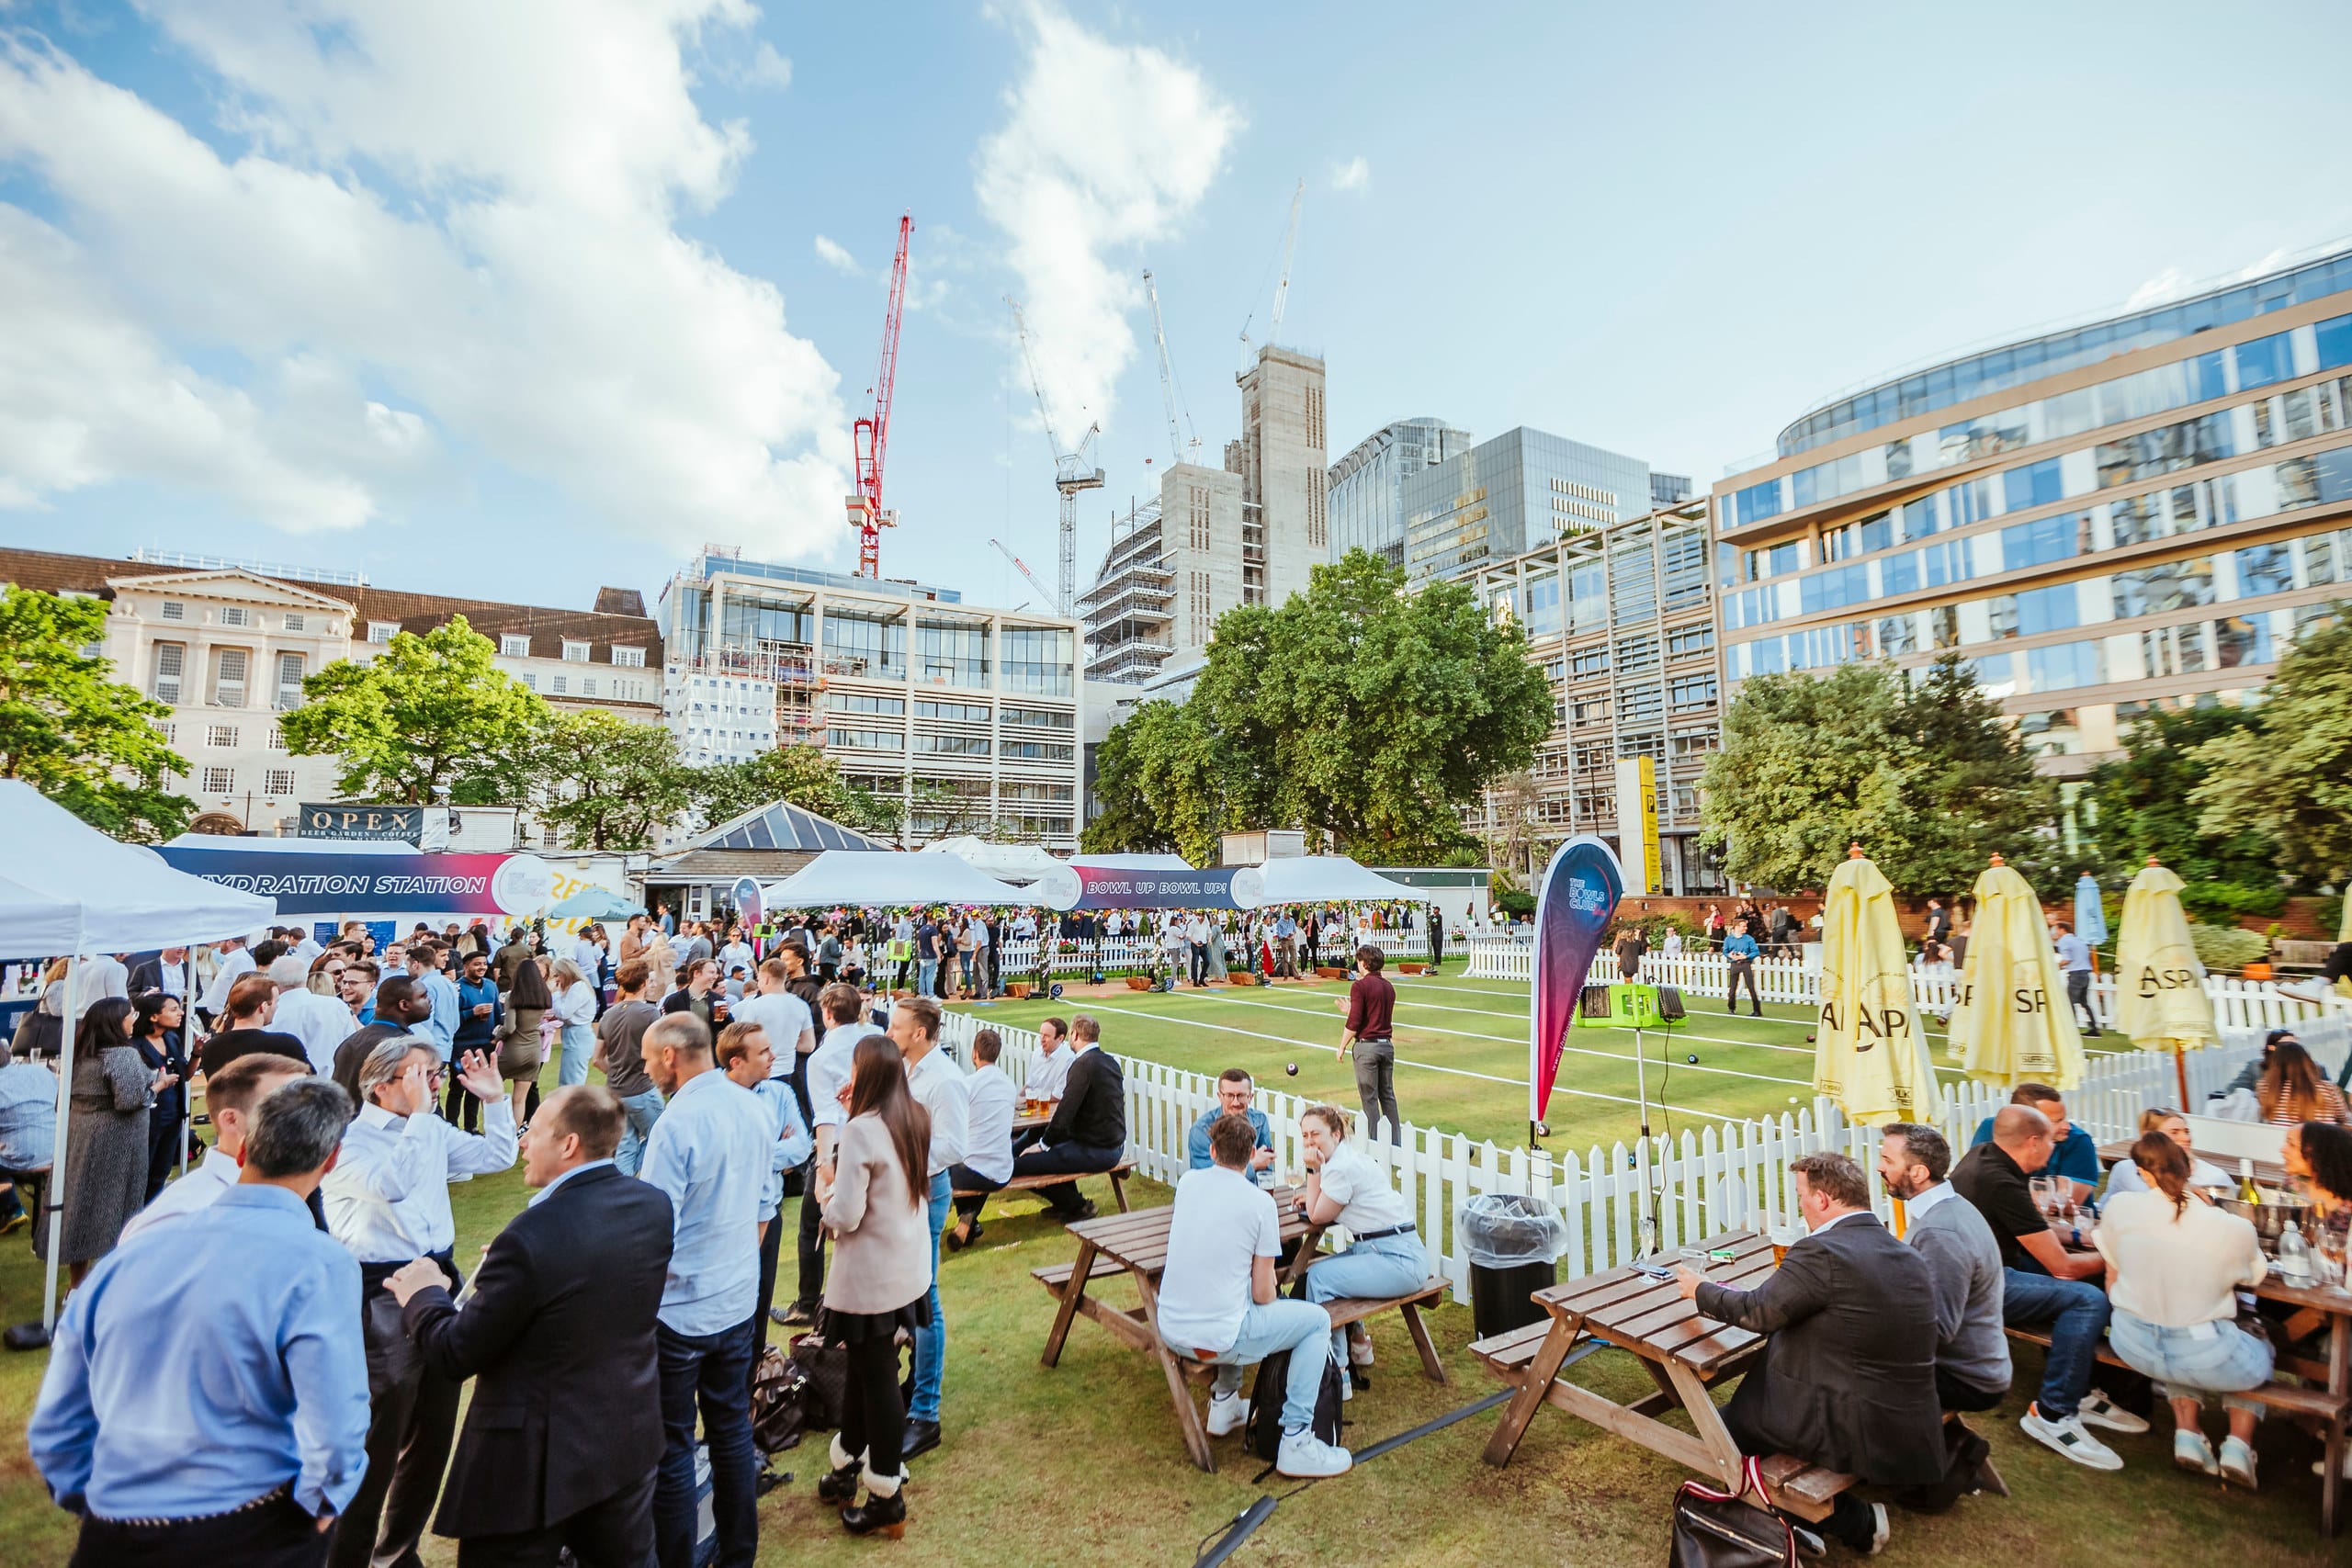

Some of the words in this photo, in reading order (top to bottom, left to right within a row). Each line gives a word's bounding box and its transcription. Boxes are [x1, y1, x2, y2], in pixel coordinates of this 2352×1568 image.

[311, 811, 410, 831] OPEN
[197, 874, 370, 894] YDRATION
[373, 875, 487, 895] STATION
[1086, 881, 1132, 895] BOWL
[1135, 882, 1156, 895] UP
[1159, 882, 1201, 895] BOWL
[1204, 882, 1227, 895] UP!
[1569, 877, 1586, 888] THE
[1568, 886, 1605, 902] BOWLS
[1568, 897, 1596, 911] CLUB
